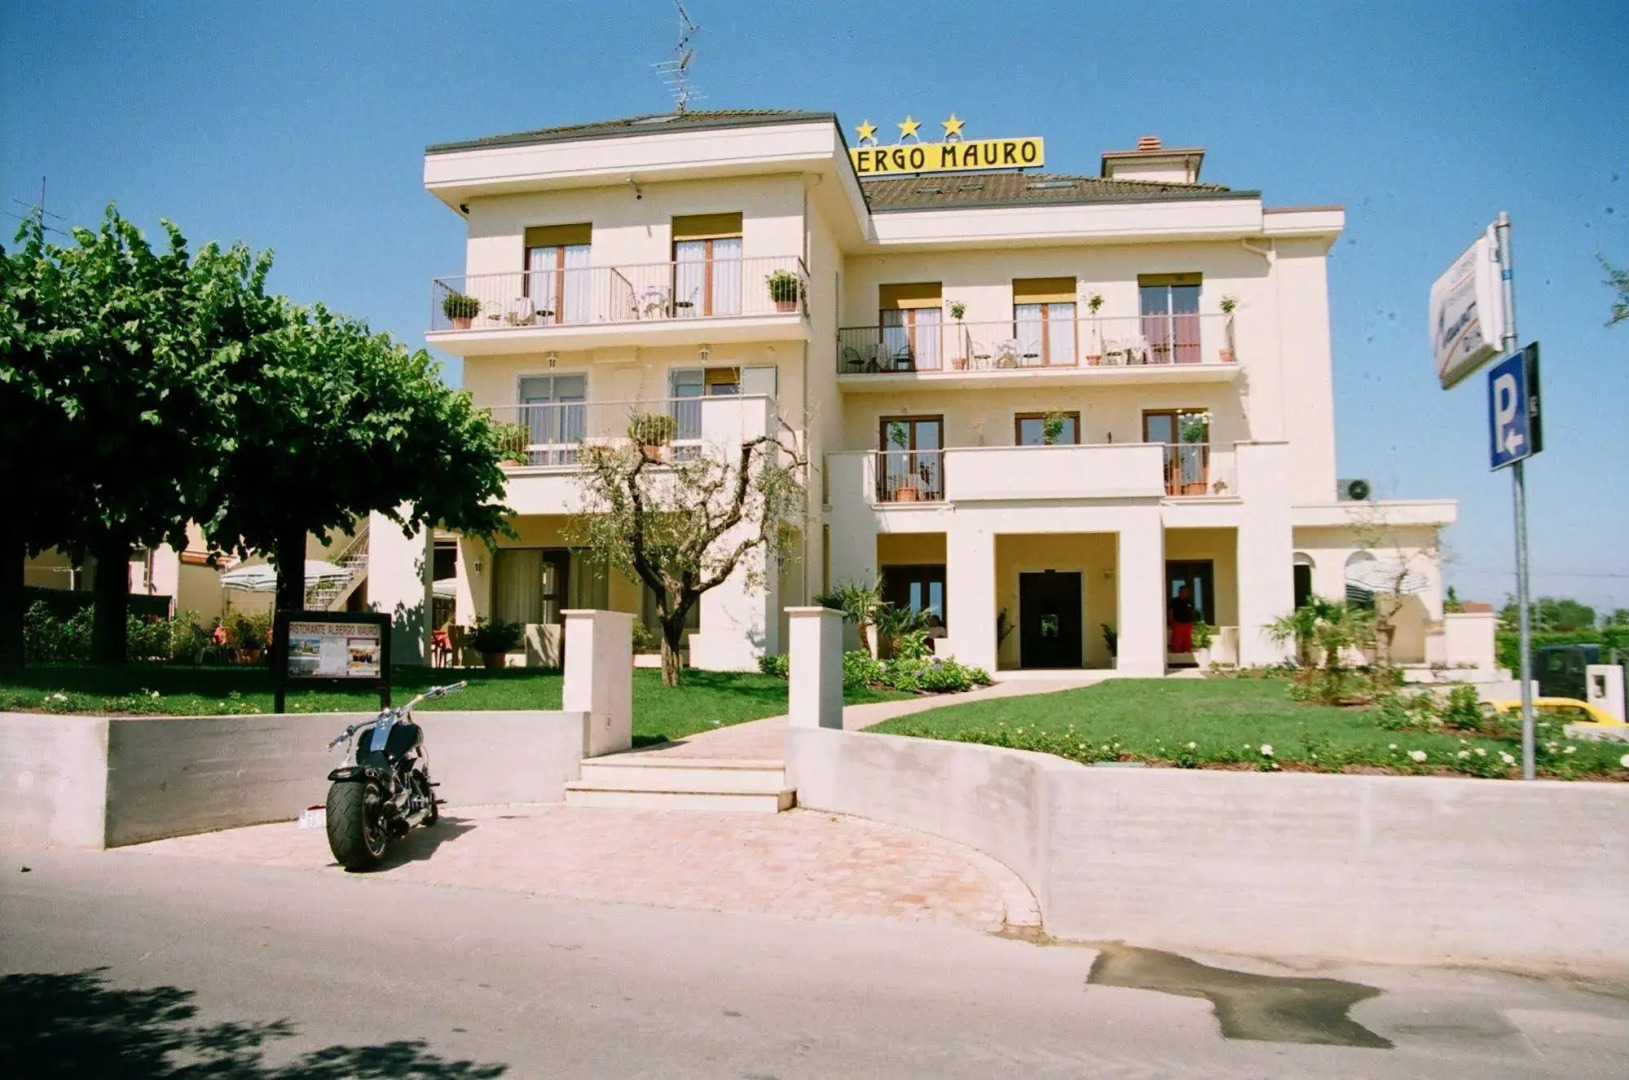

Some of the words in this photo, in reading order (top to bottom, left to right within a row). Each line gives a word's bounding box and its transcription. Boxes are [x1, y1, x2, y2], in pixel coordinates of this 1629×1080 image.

[857, 148, 925, 172] ERGO
[940, 141, 1036, 168] MAURO
[1493, 373, 1517, 454] P
[290, 623, 325, 635] RISTORANTE
[328, 624, 355, 635] ALBERGO
[357, 625, 378, 636] MAURO
